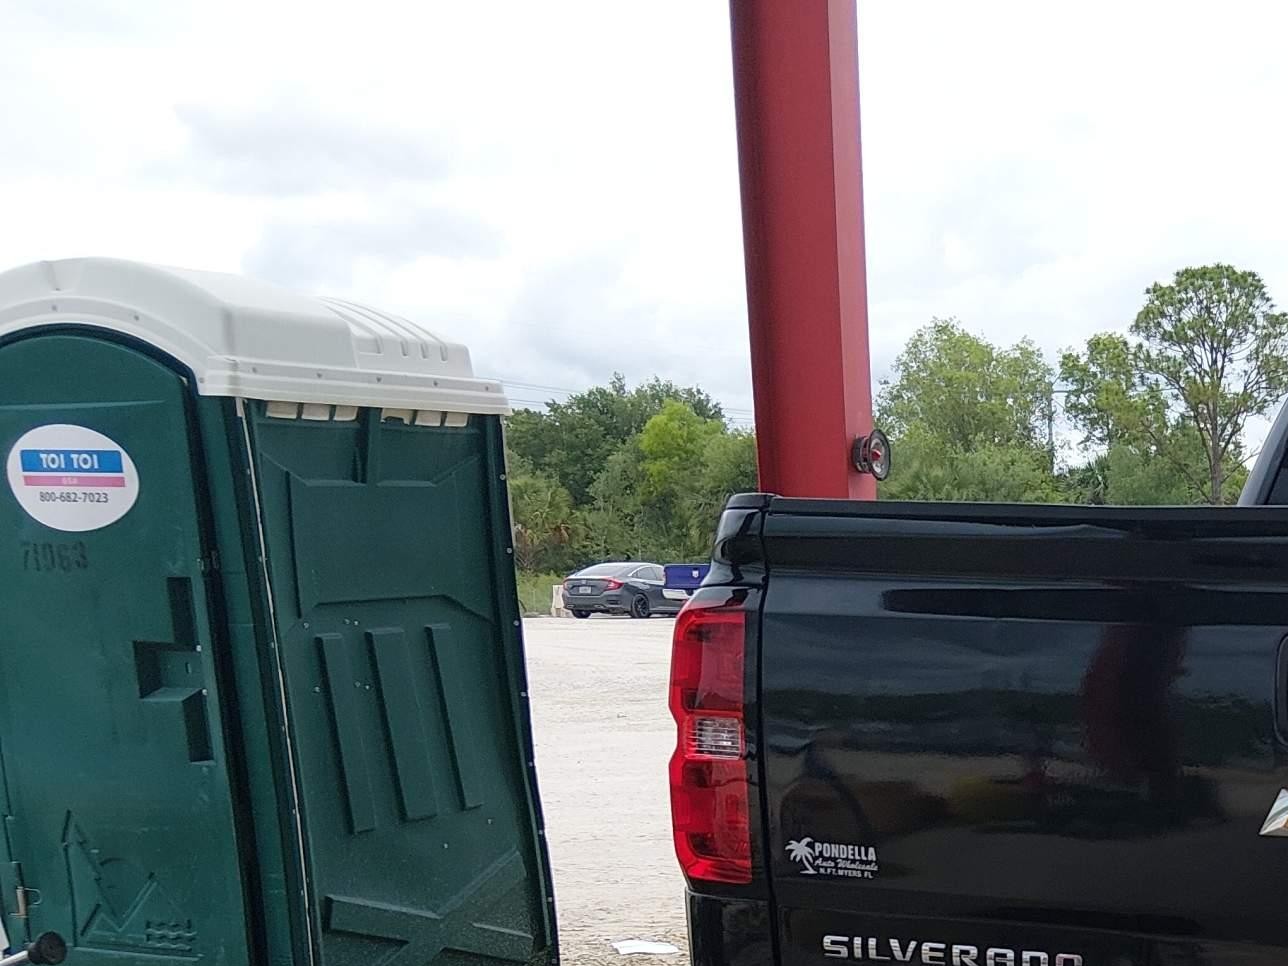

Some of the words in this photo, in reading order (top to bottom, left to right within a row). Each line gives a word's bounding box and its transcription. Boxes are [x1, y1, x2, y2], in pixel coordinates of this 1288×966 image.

[40, 453, 66, 469] TOI
[70, 453, 99, 470] TOI
[39, 491, 109, 503] 800-682-7023
[814, 842, 876, 861] PONDELLA
[814, 858, 835, 866] Auto
[863, 871, 874, 879] FL
